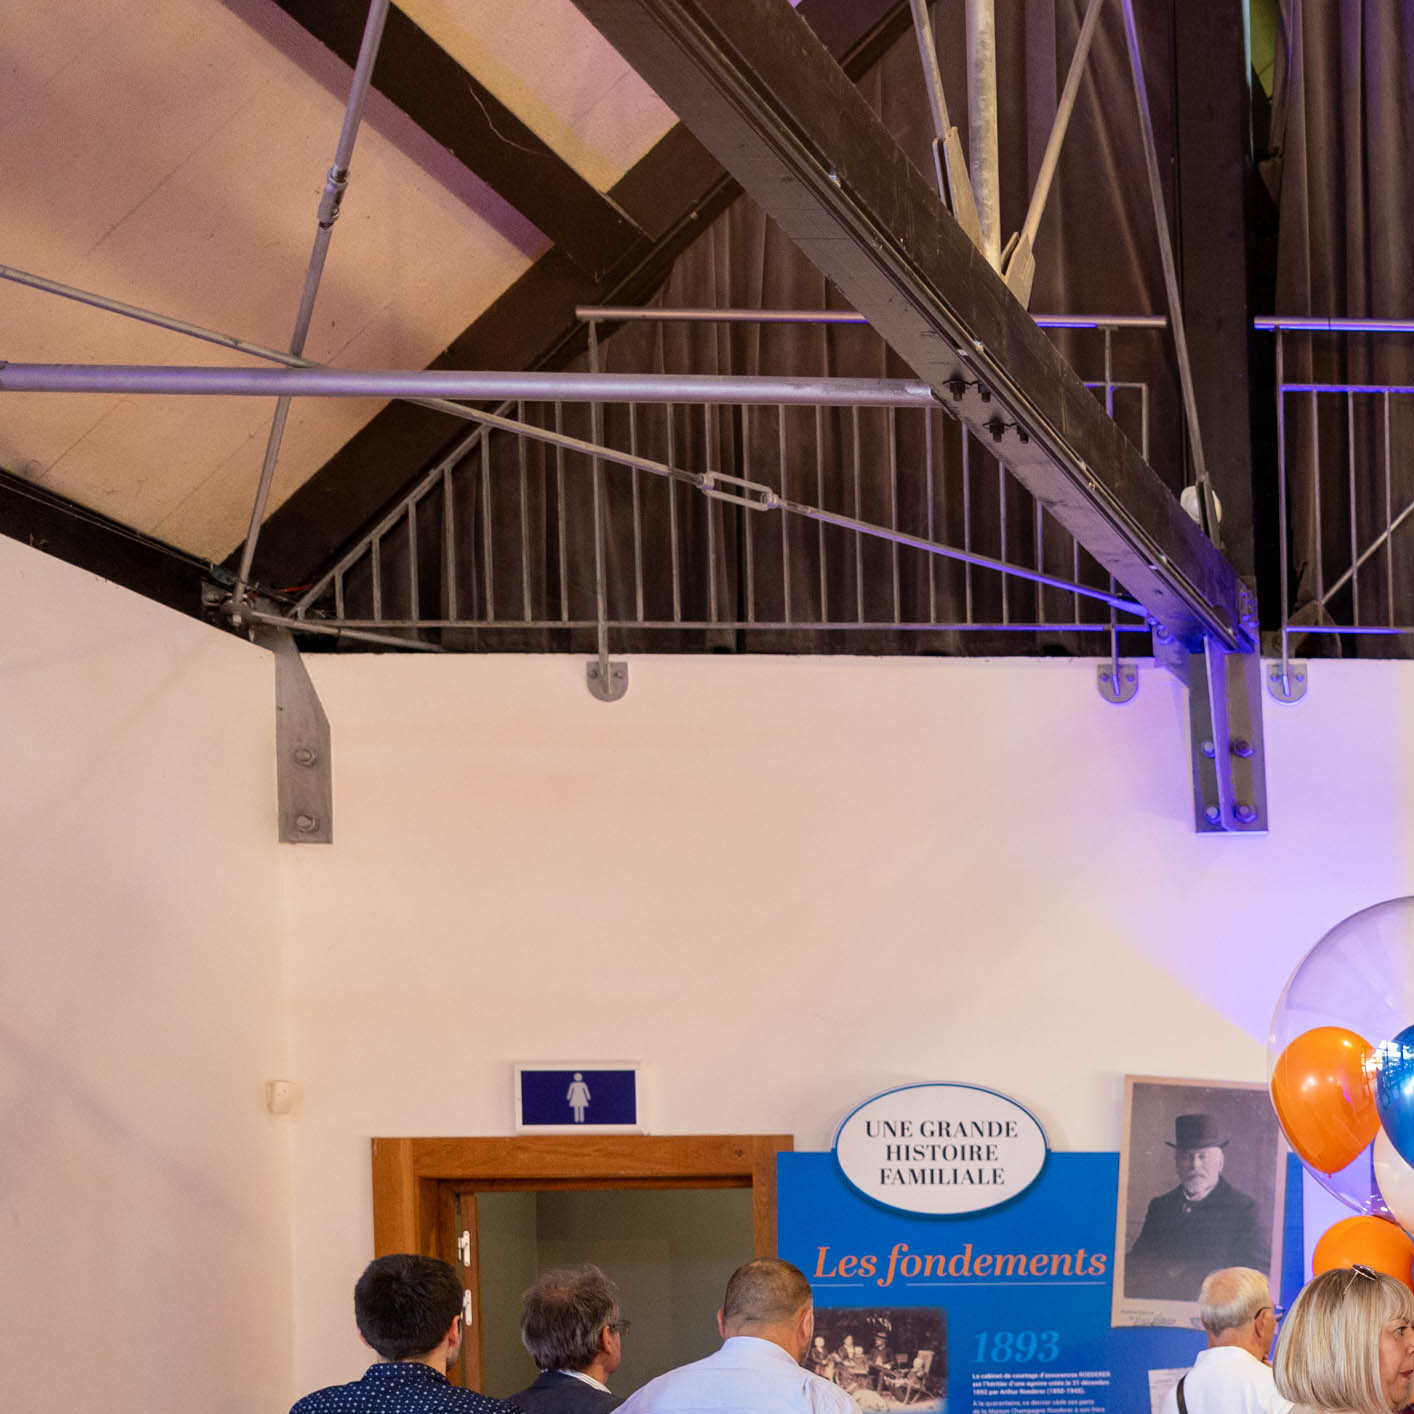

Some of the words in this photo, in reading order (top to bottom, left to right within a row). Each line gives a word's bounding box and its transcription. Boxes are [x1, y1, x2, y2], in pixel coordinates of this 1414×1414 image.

[865, 1120, 912, 1138] UNE
[921, 1120, 1018, 1138] GRANDE
[885, 1144, 998, 1161] HISTOIRE
[879, 1168, 1005, 1186] FAMILIALE
[814, 1246, 876, 1279] Les
[876, 1243, 1106, 1286] fondements
[972, 1330, 1060, 1363] 1893
